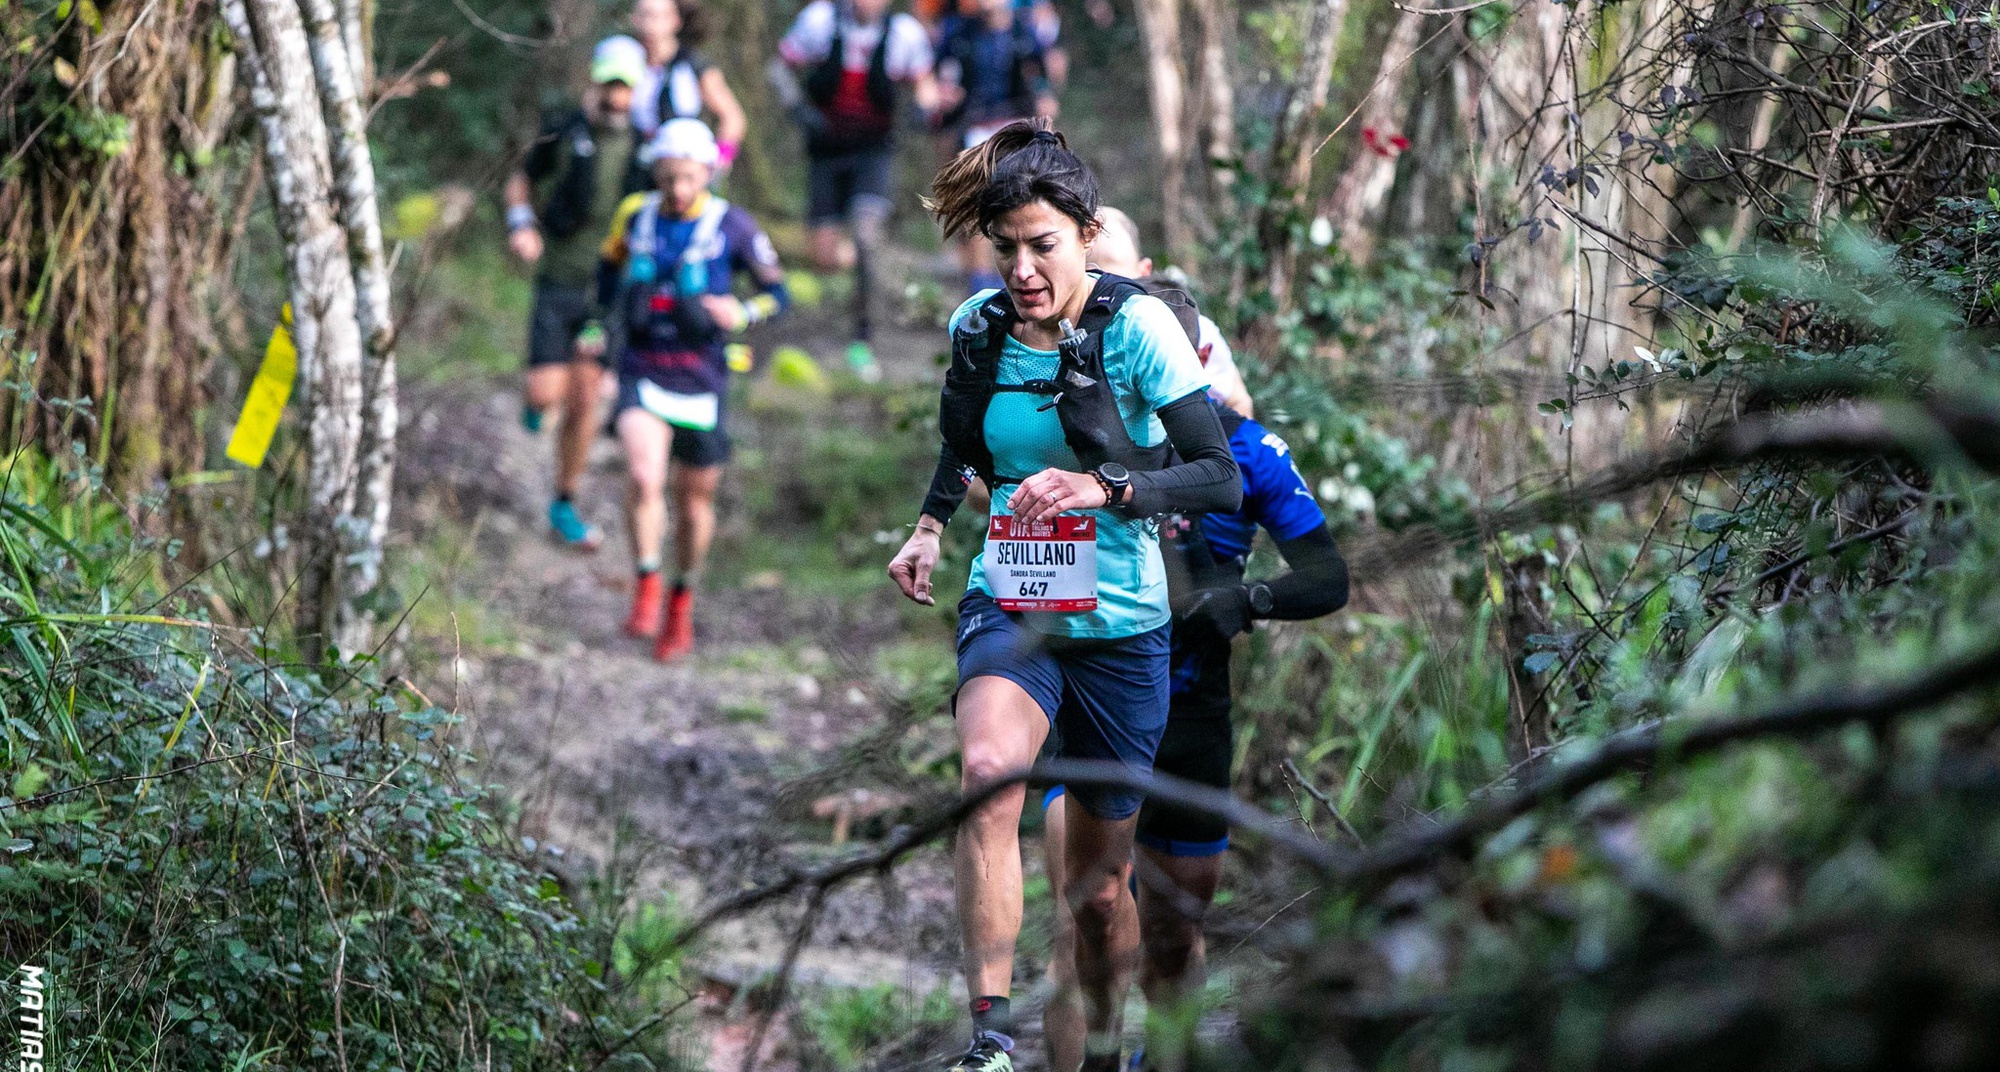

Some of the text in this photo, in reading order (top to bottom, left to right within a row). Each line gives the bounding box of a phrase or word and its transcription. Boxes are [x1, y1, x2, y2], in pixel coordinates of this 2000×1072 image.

[998, 542, 1075, 565] SEVILLANO
[1029, 570, 1056, 578] SEVILLANO
[1019, 581, 1048, 597] 647
